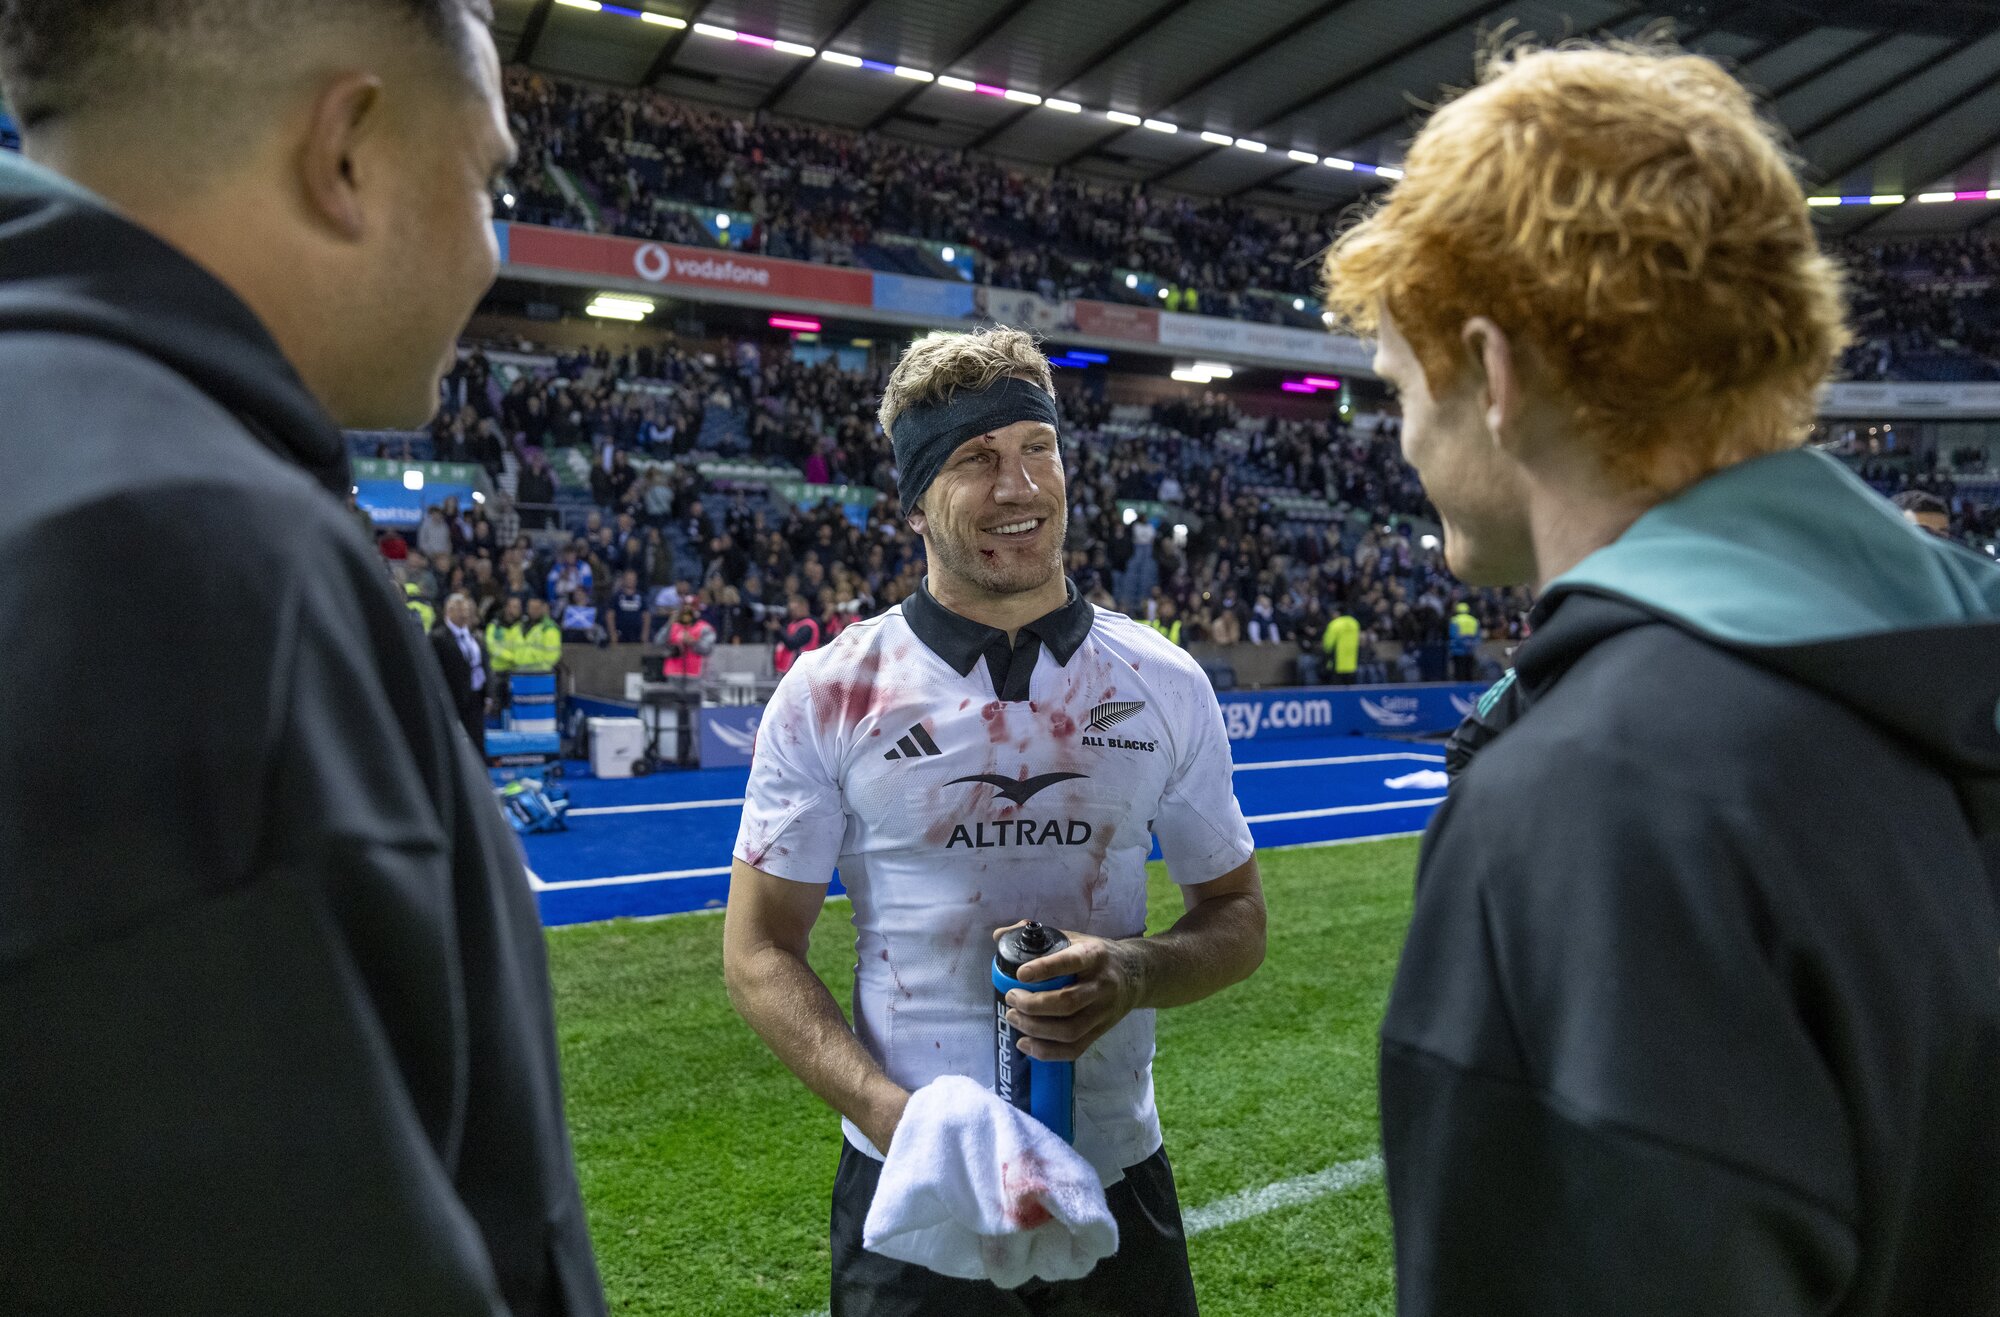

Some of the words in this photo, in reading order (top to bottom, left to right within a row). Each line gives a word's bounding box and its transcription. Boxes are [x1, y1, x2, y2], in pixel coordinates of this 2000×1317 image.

[673, 257, 770, 287] vodafone
[1082, 736, 1105, 747] ALL
[1107, 738, 1155, 752] BLACKS
[945, 819, 1092, 849] ALTRAD
